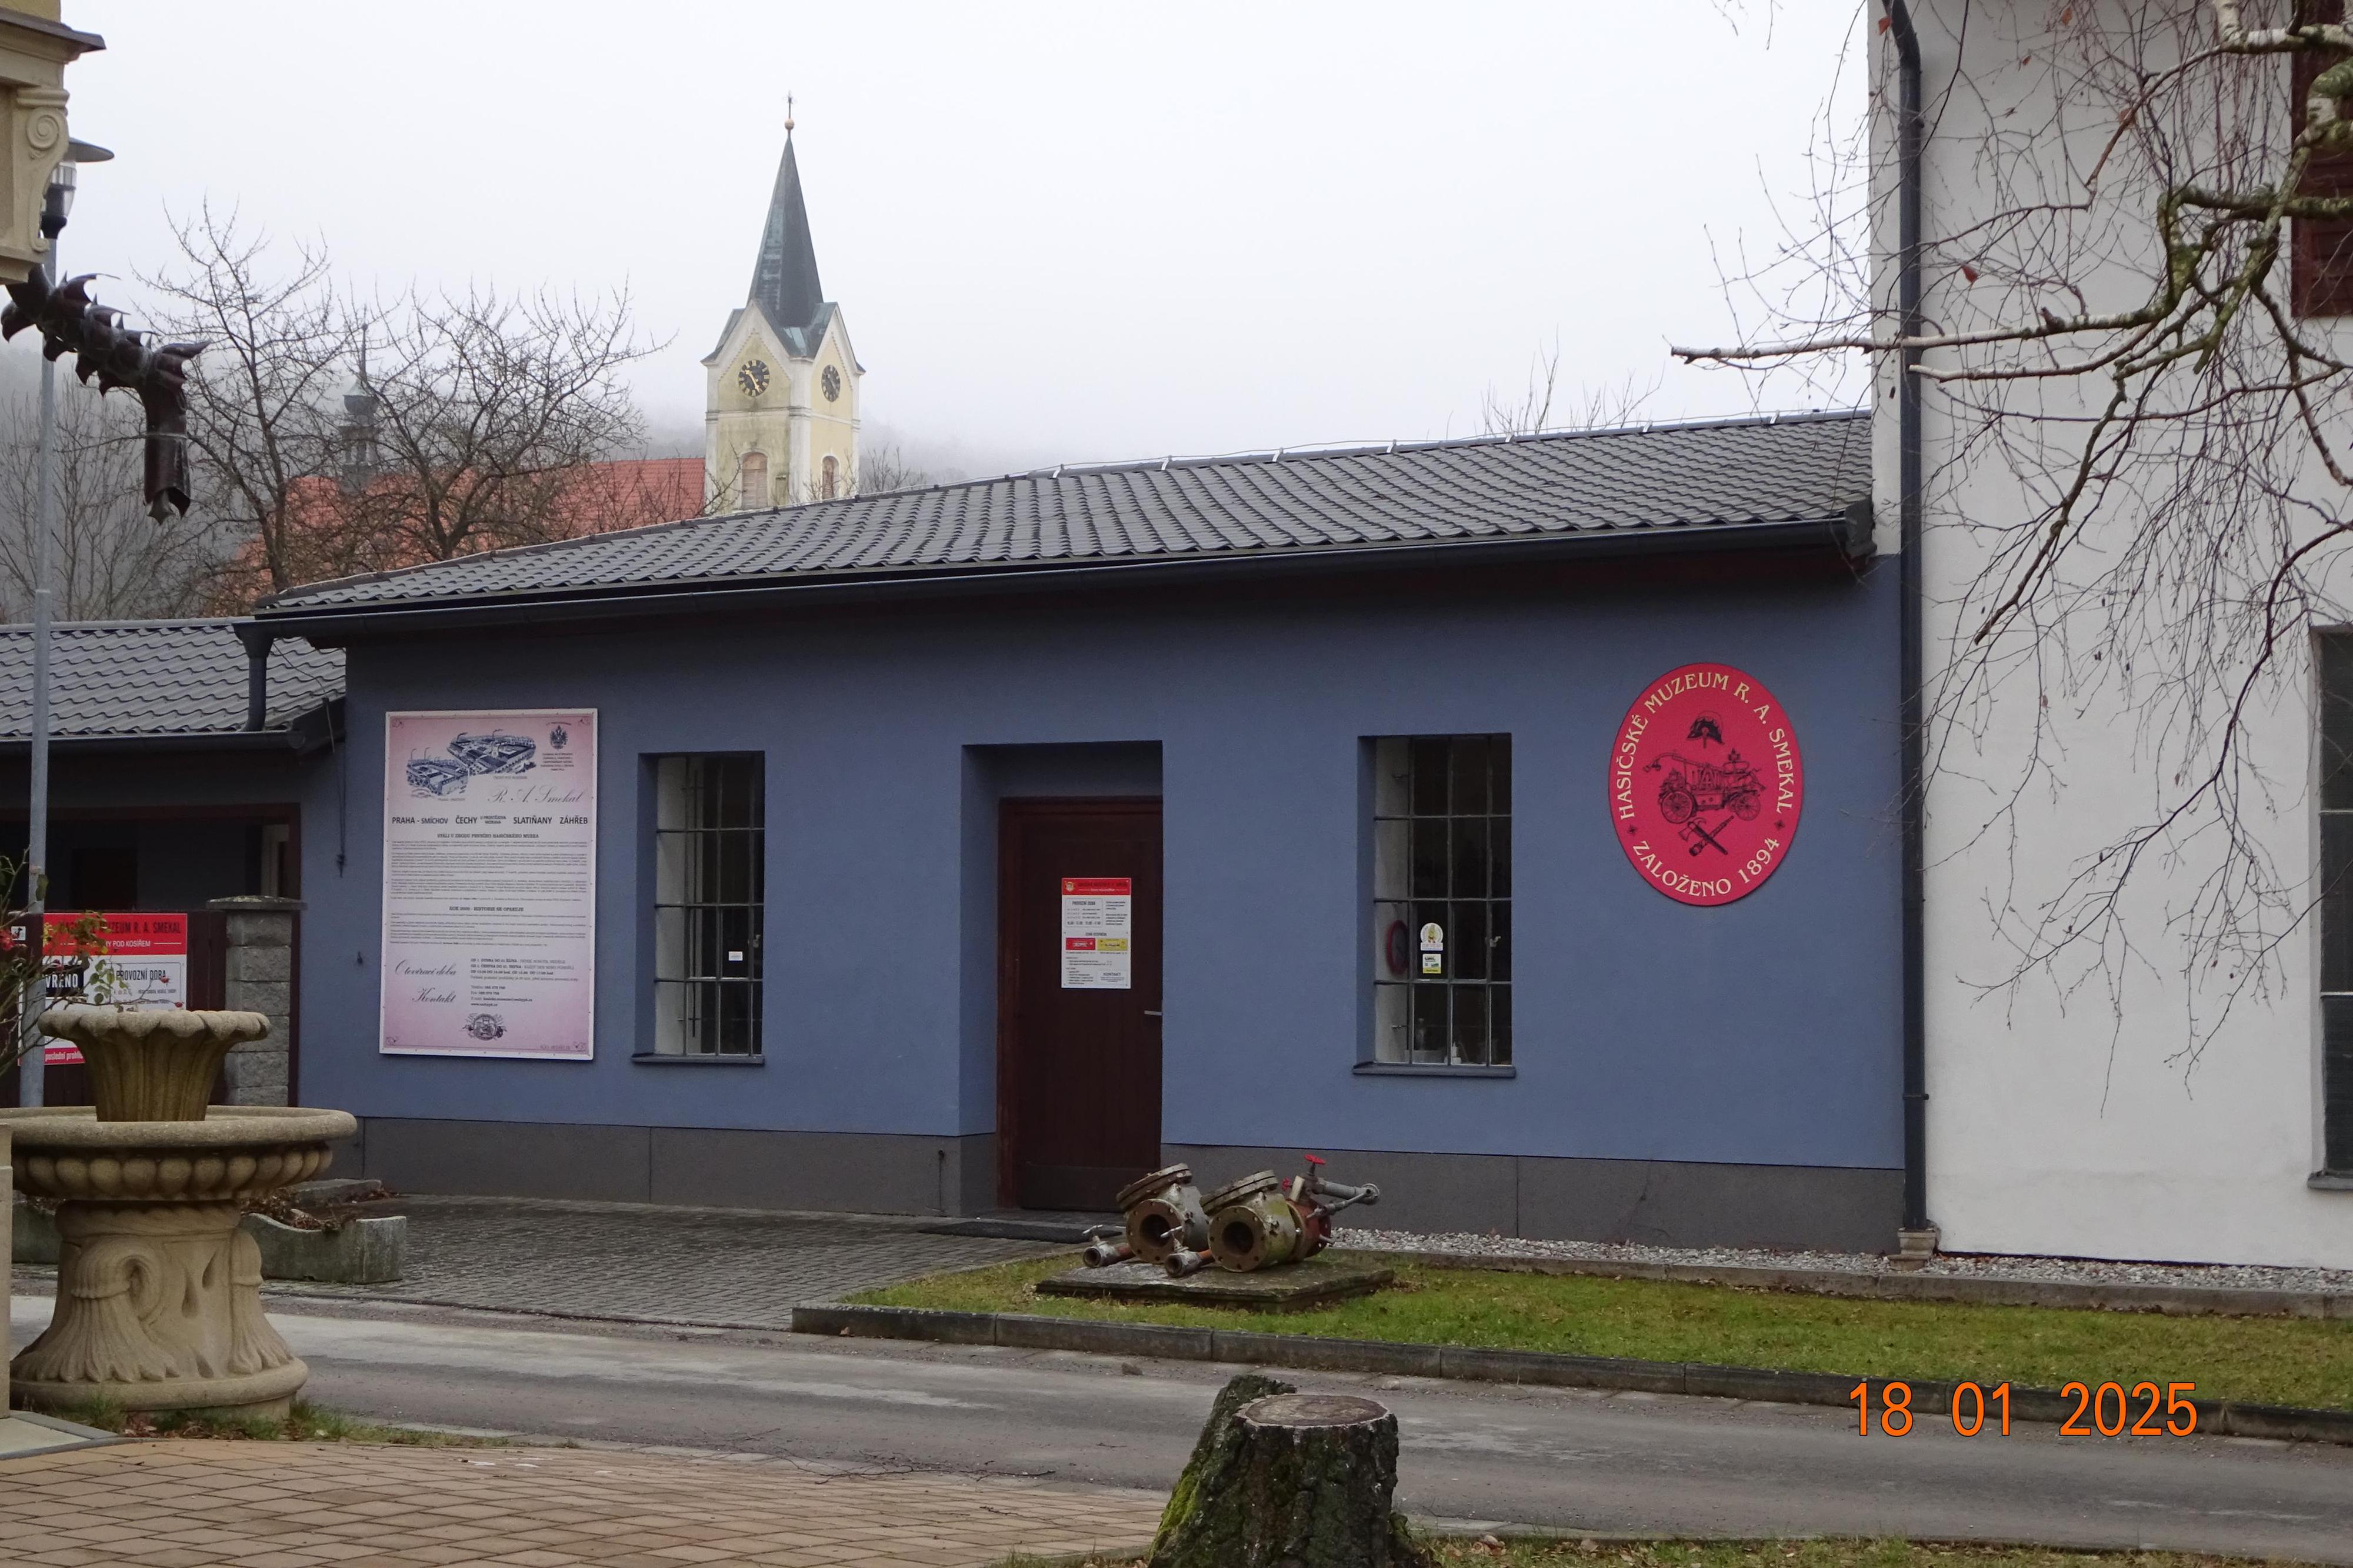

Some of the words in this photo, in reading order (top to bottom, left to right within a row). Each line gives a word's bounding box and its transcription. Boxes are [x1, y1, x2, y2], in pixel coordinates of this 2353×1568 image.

[1616, 714, 1648, 820] HASIČSKÉ
[1644, 672, 1729, 713] MUZEUM
[1734, 682, 1750, 703] R.
[1753, 704, 1770, 724] A.
[1769, 728, 1794, 814] SMEKAL
[421, 816, 448, 824] SMÍCHOV
[455, 815, 478, 824] ČECHY
[513, 815, 552, 824] SLATIŇANY
[559, 815, 588, 824] ZÁHŘEB
[1632, 840, 1732, 897] ZALOŽENO
[1738, 838, 1780, 884] 1894
[153, 922, 181, 934] SMEKAL
[116, 968, 147, 981] PROVOZNÍ
